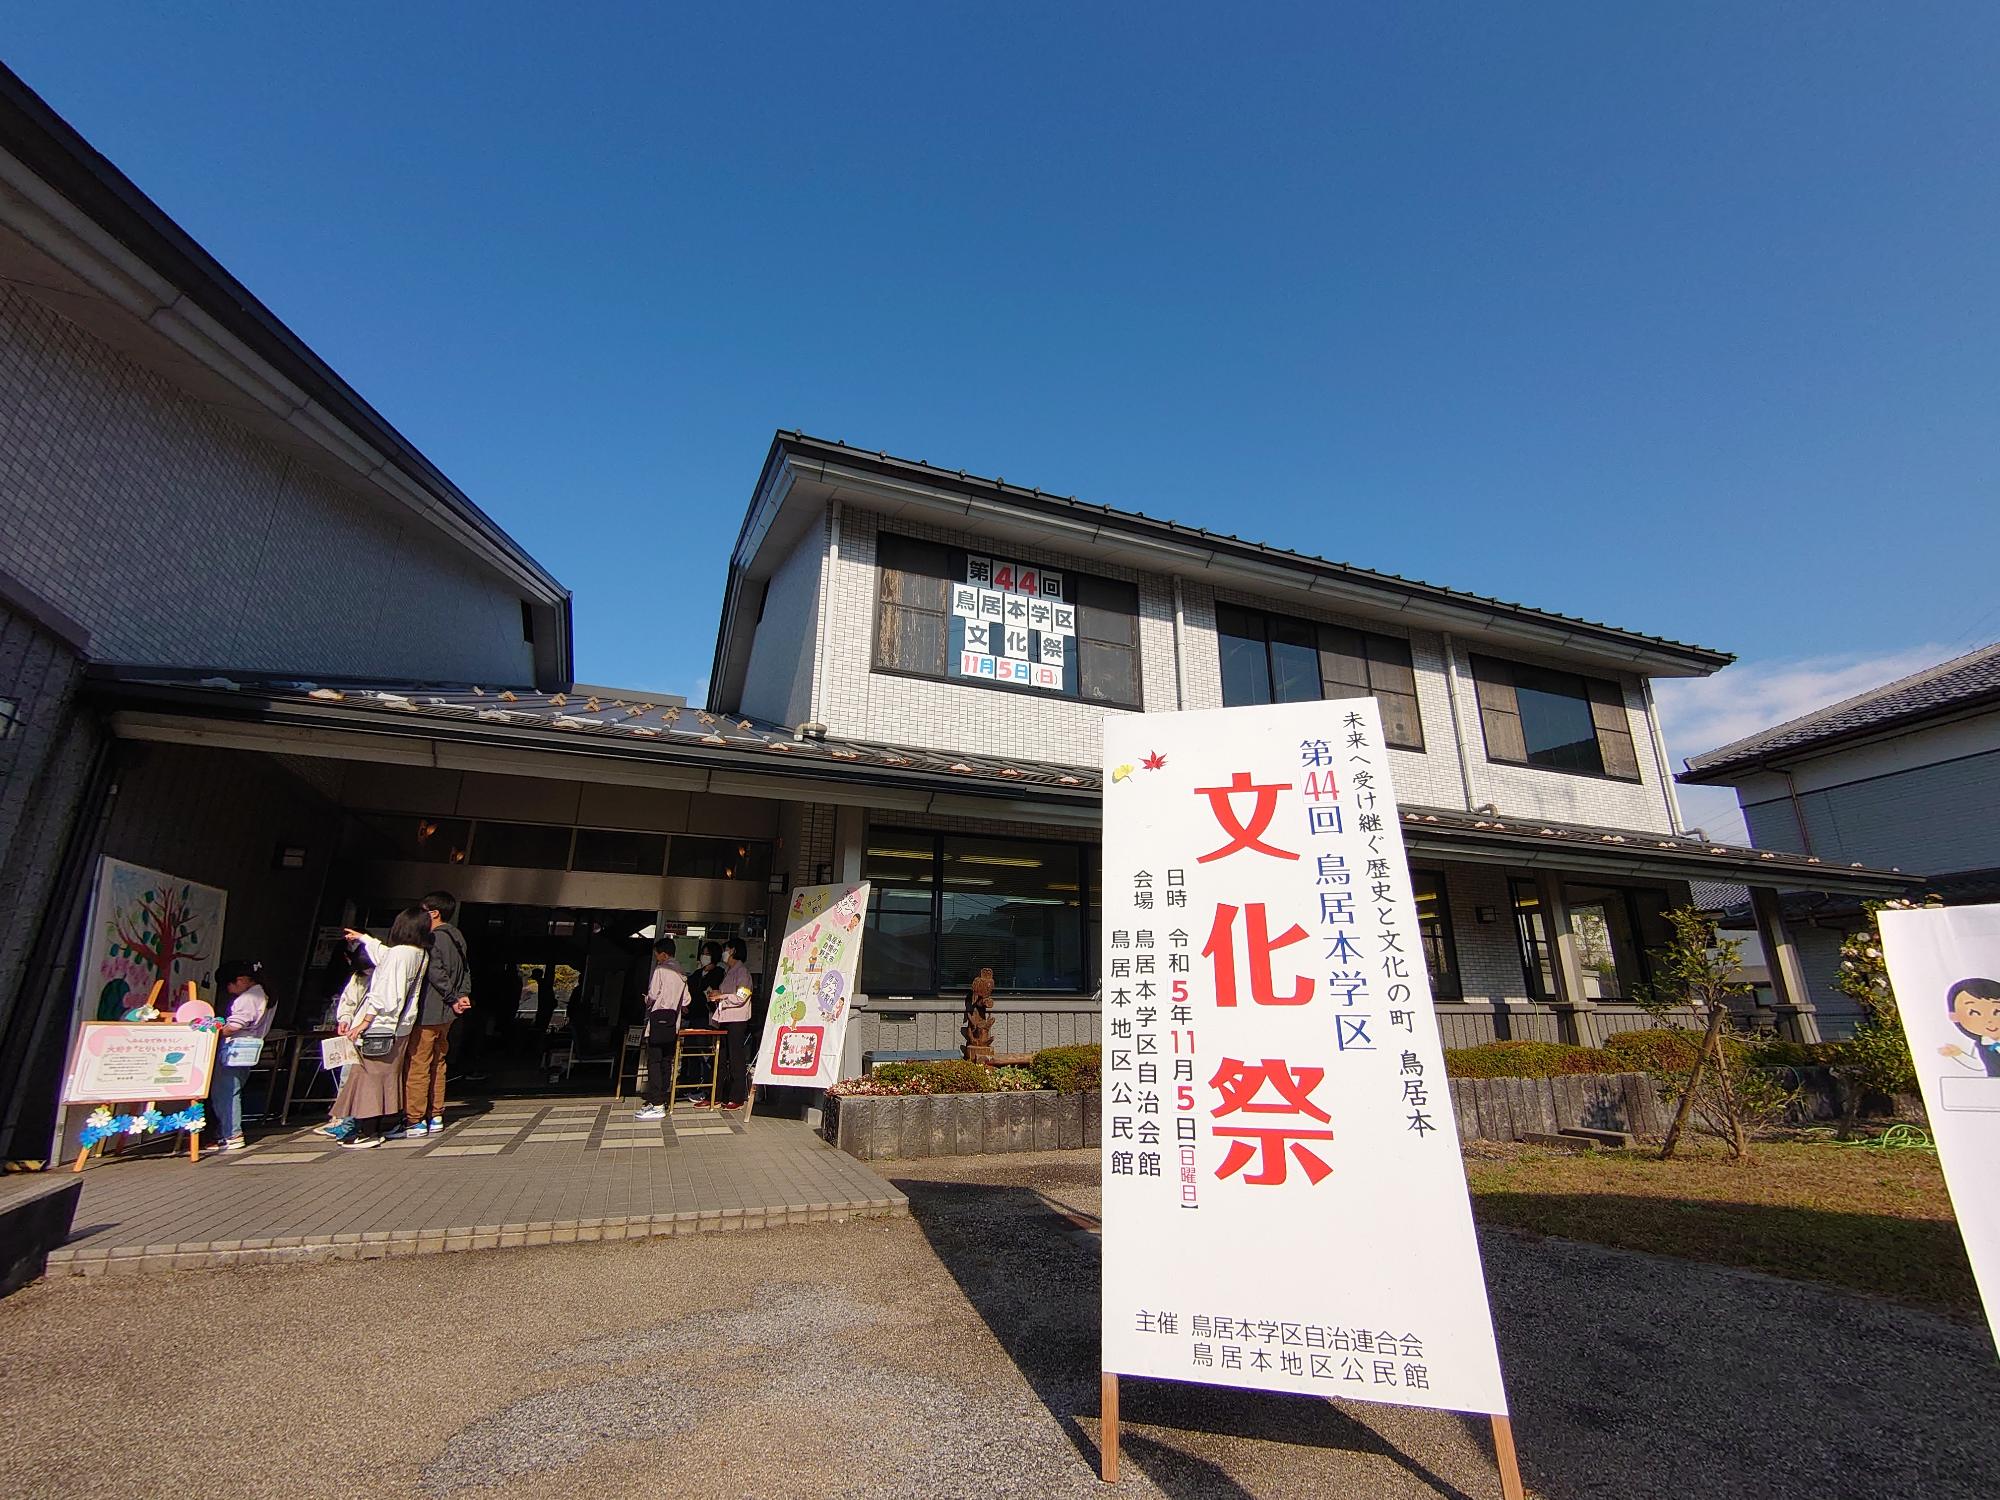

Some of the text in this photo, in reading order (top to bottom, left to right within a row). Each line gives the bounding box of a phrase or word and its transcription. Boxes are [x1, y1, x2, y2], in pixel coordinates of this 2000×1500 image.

[969, 560, 1061, 598] 第44回
[955, 590, 1073, 630] 鳥居本学区
[967, 625, 1062, 659] 文化祭
[1167, 869, 1187, 908] 日時
[1300, 740, 1377, 1051] 第44回 鳥居本学区
[1342, 711, 1437, 1138] 未来へ受け継ぐ歴史と文化の町 鳥居本
[1193, 772, 1334, 1186] 文化祭
[1134, 870, 1161, 1177] 会場 鳥居本学区自治会館
[1110, 930, 1134, 1177] 鳥居本地区公民館
[1135, 1309, 1424, 1359] 主催 鳥居本学区自治連合会
[1192, 1342, 1429, 1390] 鳥居本地区公民館
